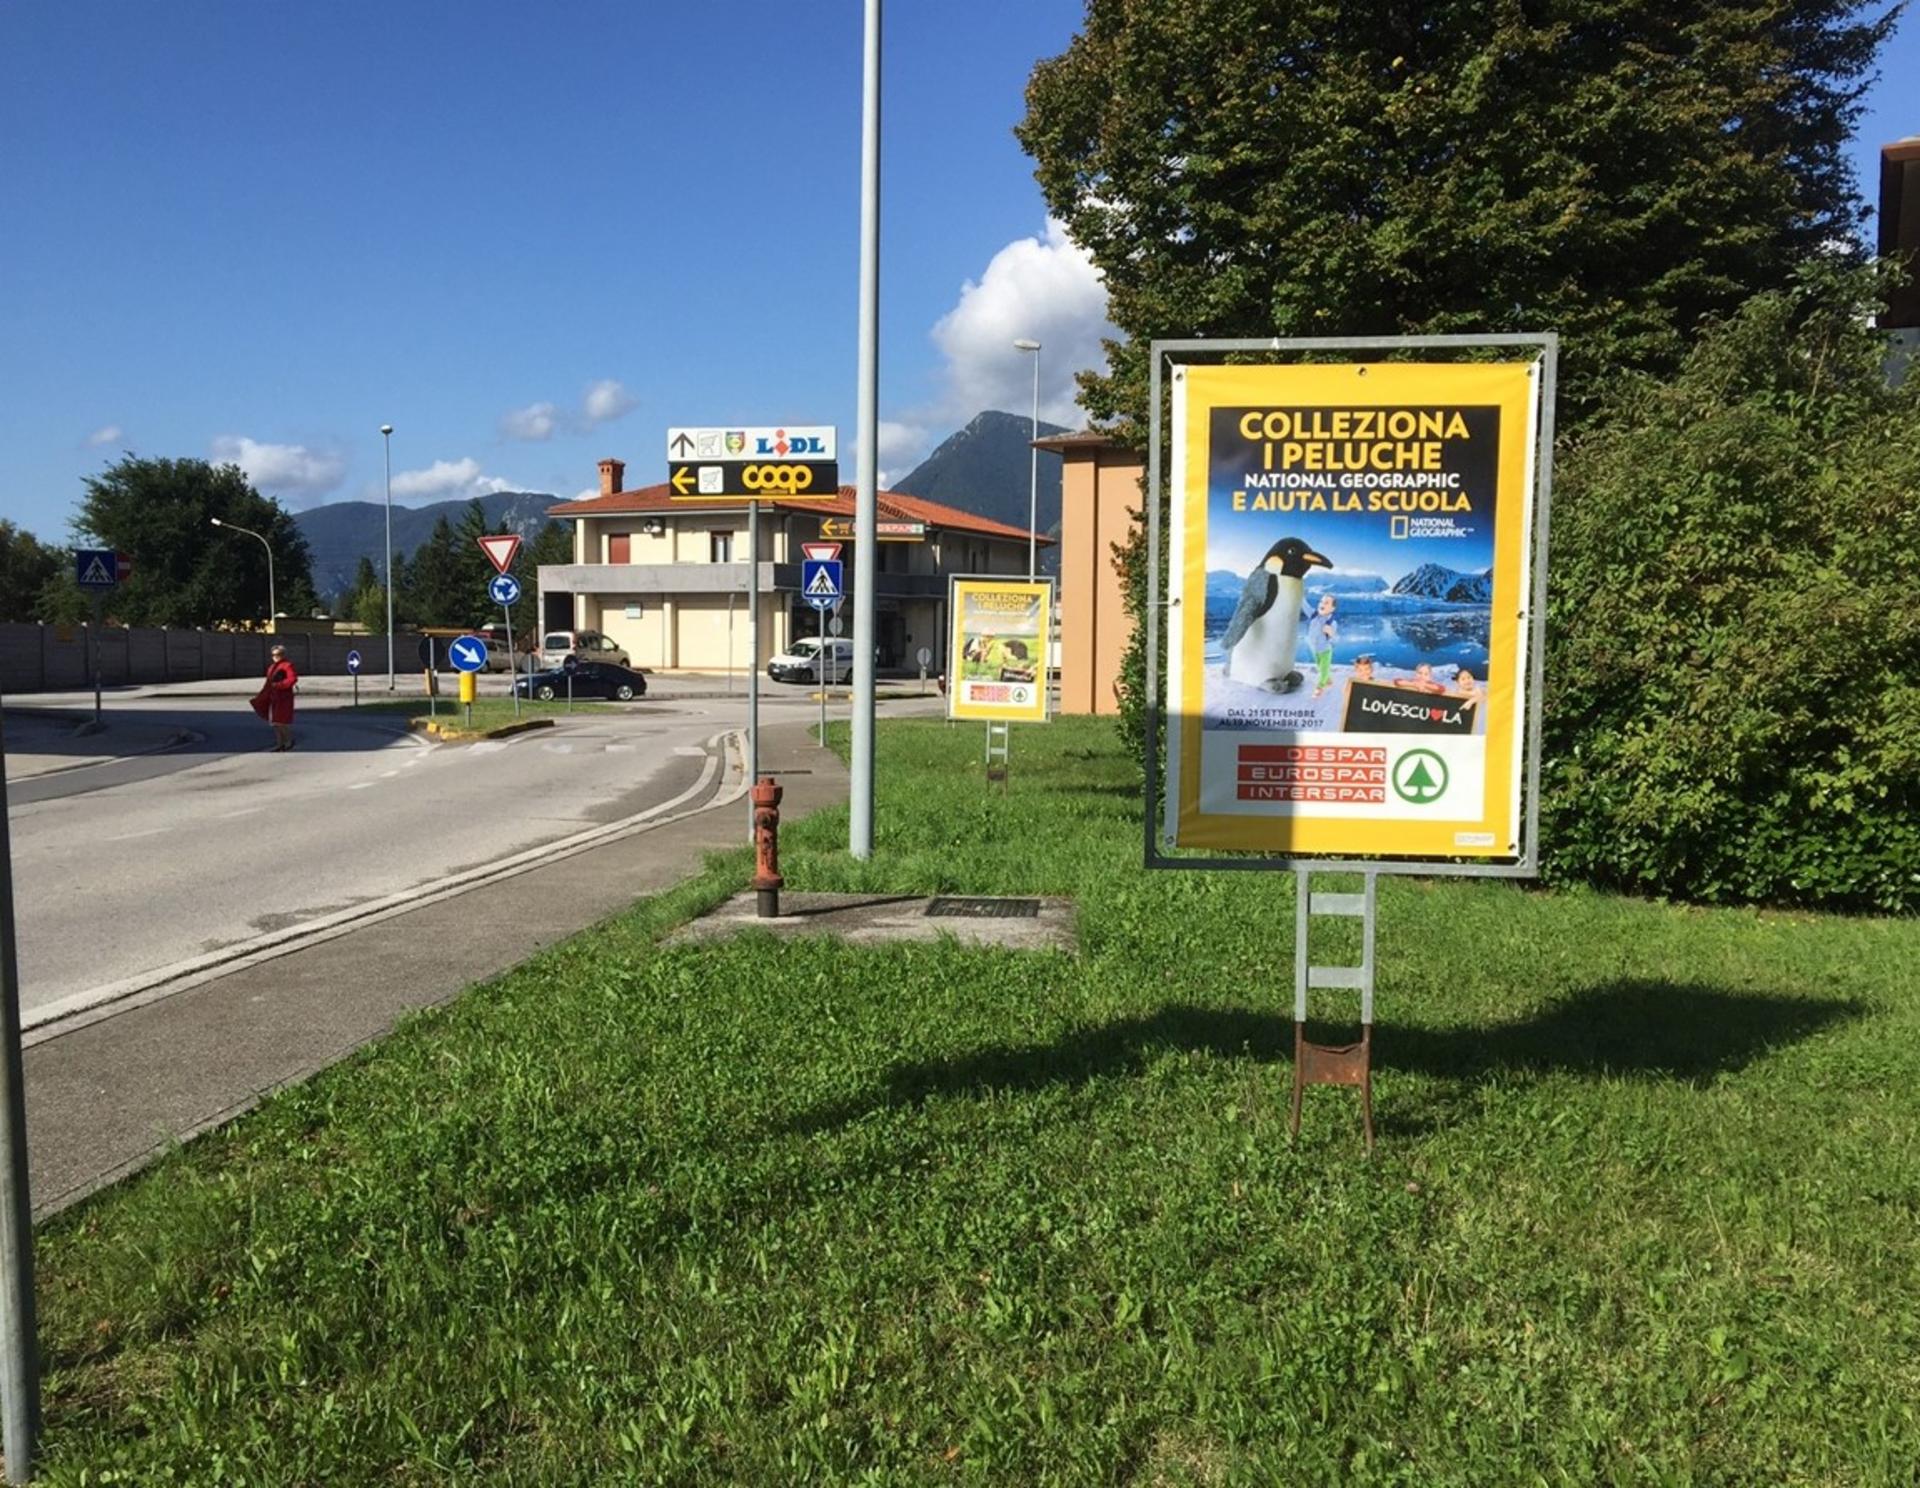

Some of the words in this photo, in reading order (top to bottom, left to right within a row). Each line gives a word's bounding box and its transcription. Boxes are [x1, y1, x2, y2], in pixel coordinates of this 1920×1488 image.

[1239, 411, 1470, 440] COLLEZIONA
[1264, 442, 1272, 470] I
[1282, 442, 1442, 470] PELUCHE
[1244, 473, 1337, 489] NATIONAL
[1340, 472, 1460, 488] GEOGRAPHIC
[1232, 491, 1247, 511] E
[1251, 491, 1327, 511] AIUTA
[1332, 491, 1363, 511] LA
[1367, 490, 1472, 511] SCUOLA
[1410, 518, 1455, 527] NATIONAL
[1227, 708, 1246, 717] DAL
[1260, 709, 1315, 718] SETTEMBRE
[1244, 718, 1299, 728] NOVEMBRE
[1301, 719, 1324, 728] 2017
[1287, 748, 1385, 762] DESPAR
[1252, 767, 1385, 781] EUROSPAR
[1250, 786, 1385, 800] INTERSPAR
